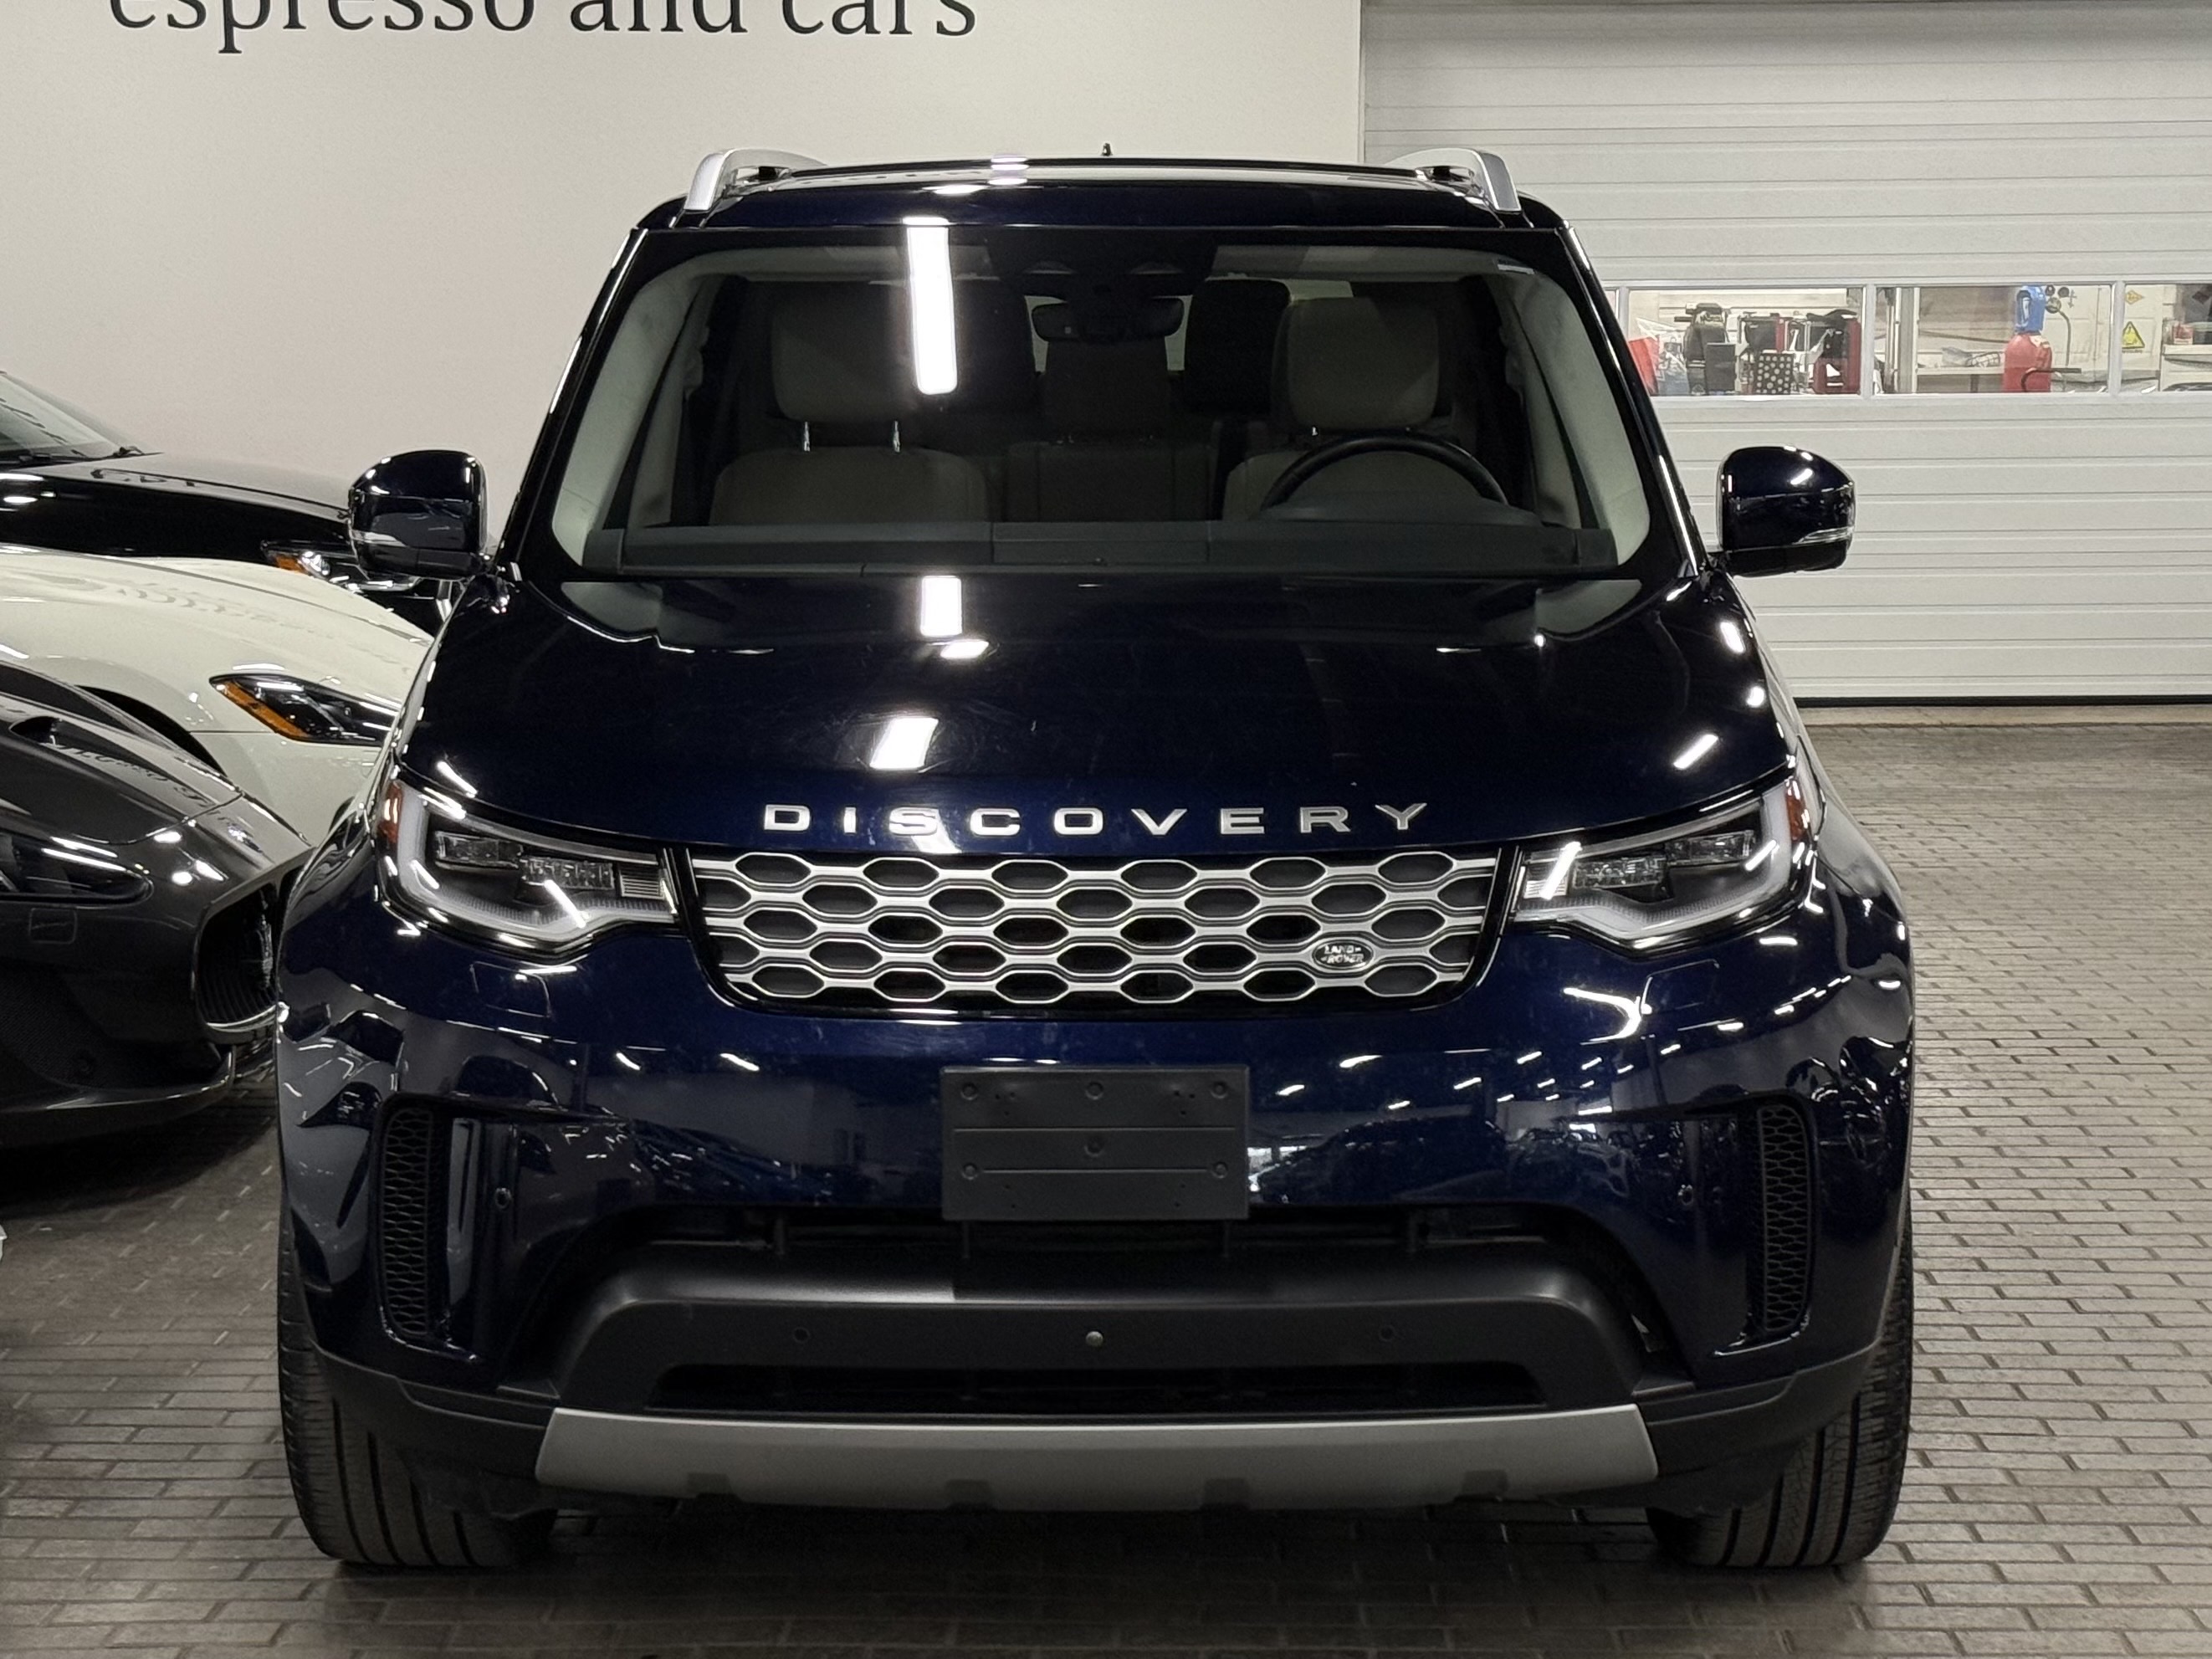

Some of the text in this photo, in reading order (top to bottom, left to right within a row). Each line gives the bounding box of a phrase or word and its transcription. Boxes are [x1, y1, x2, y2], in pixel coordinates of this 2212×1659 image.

[110, 0, 535, 54] espresso
[781, 0, 976, 36] cars
[762, 802, 1427, 837] DISCOVERY
[1324, 945, 1354, 954] LAND
[1327, 954, 1365, 964] ROVER
